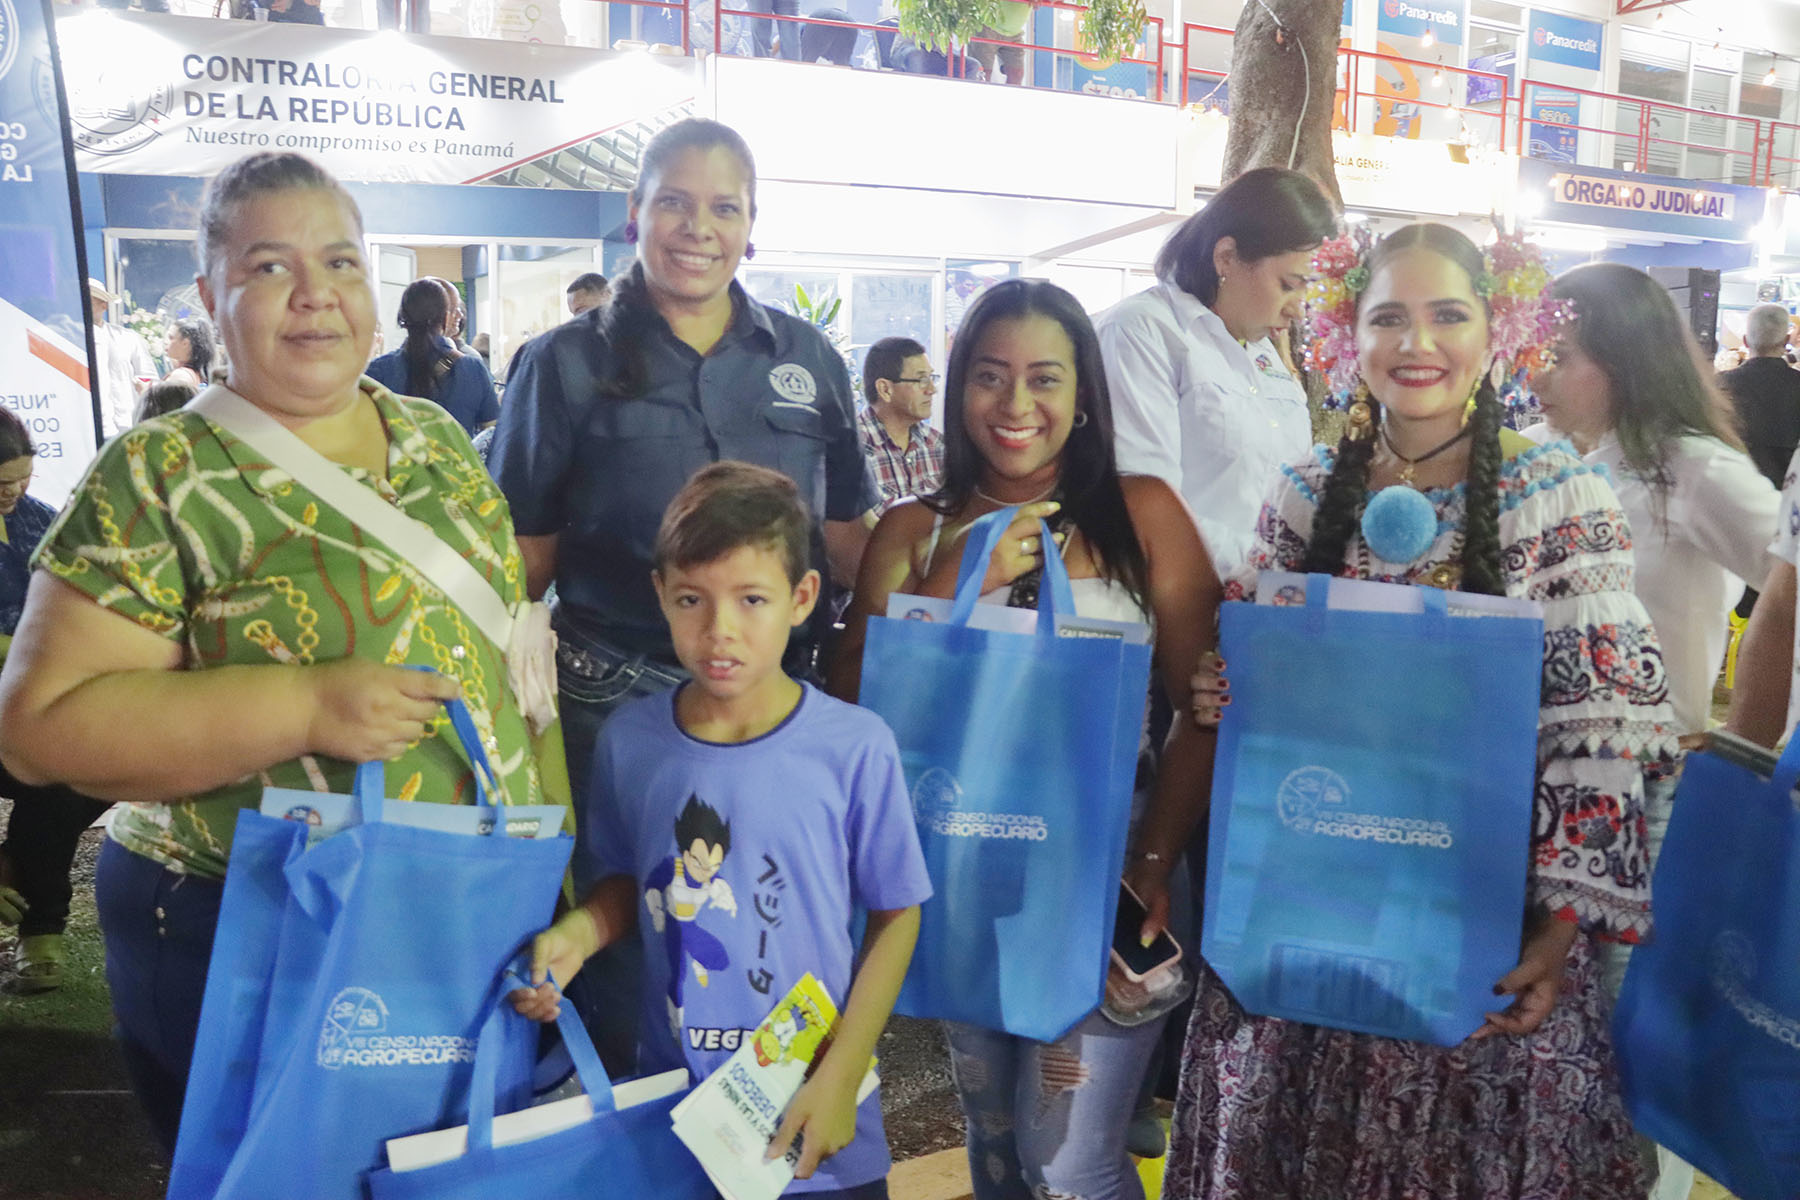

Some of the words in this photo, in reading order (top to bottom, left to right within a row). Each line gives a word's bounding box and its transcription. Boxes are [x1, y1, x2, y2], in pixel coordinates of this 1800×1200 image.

[1399, 3, 1458, 27] Panacredit
[1546, 31, 1598, 54] Panacredit
[428, 71, 565, 104] GENERAL
[184, 90, 226, 119] DE
[237, 93, 279, 122] LA
[288, 96, 466, 131] REPÚBLICA
[186, 126, 269, 146] Nuestro
[276, 132, 402, 154] compromiso
[408, 139, 428, 154] es
[434, 137, 515, 159] Panamá
[1563, 174, 1646, 209] ÓRGANO
[932, 820, 1048, 841] AGROPECUARIO
[1314, 820, 1453, 849] AGROPECUARIO
[747, 852, 786, 995] ベジータ
[367, 1035, 417, 1048] CENSO
[418, 1034, 479, 1049] NACION
[342, 1047, 476, 1067] AGROPECUAR
[729, 1062, 777, 1120] DERECHOS
[784, 1151, 799, 1168] LO
